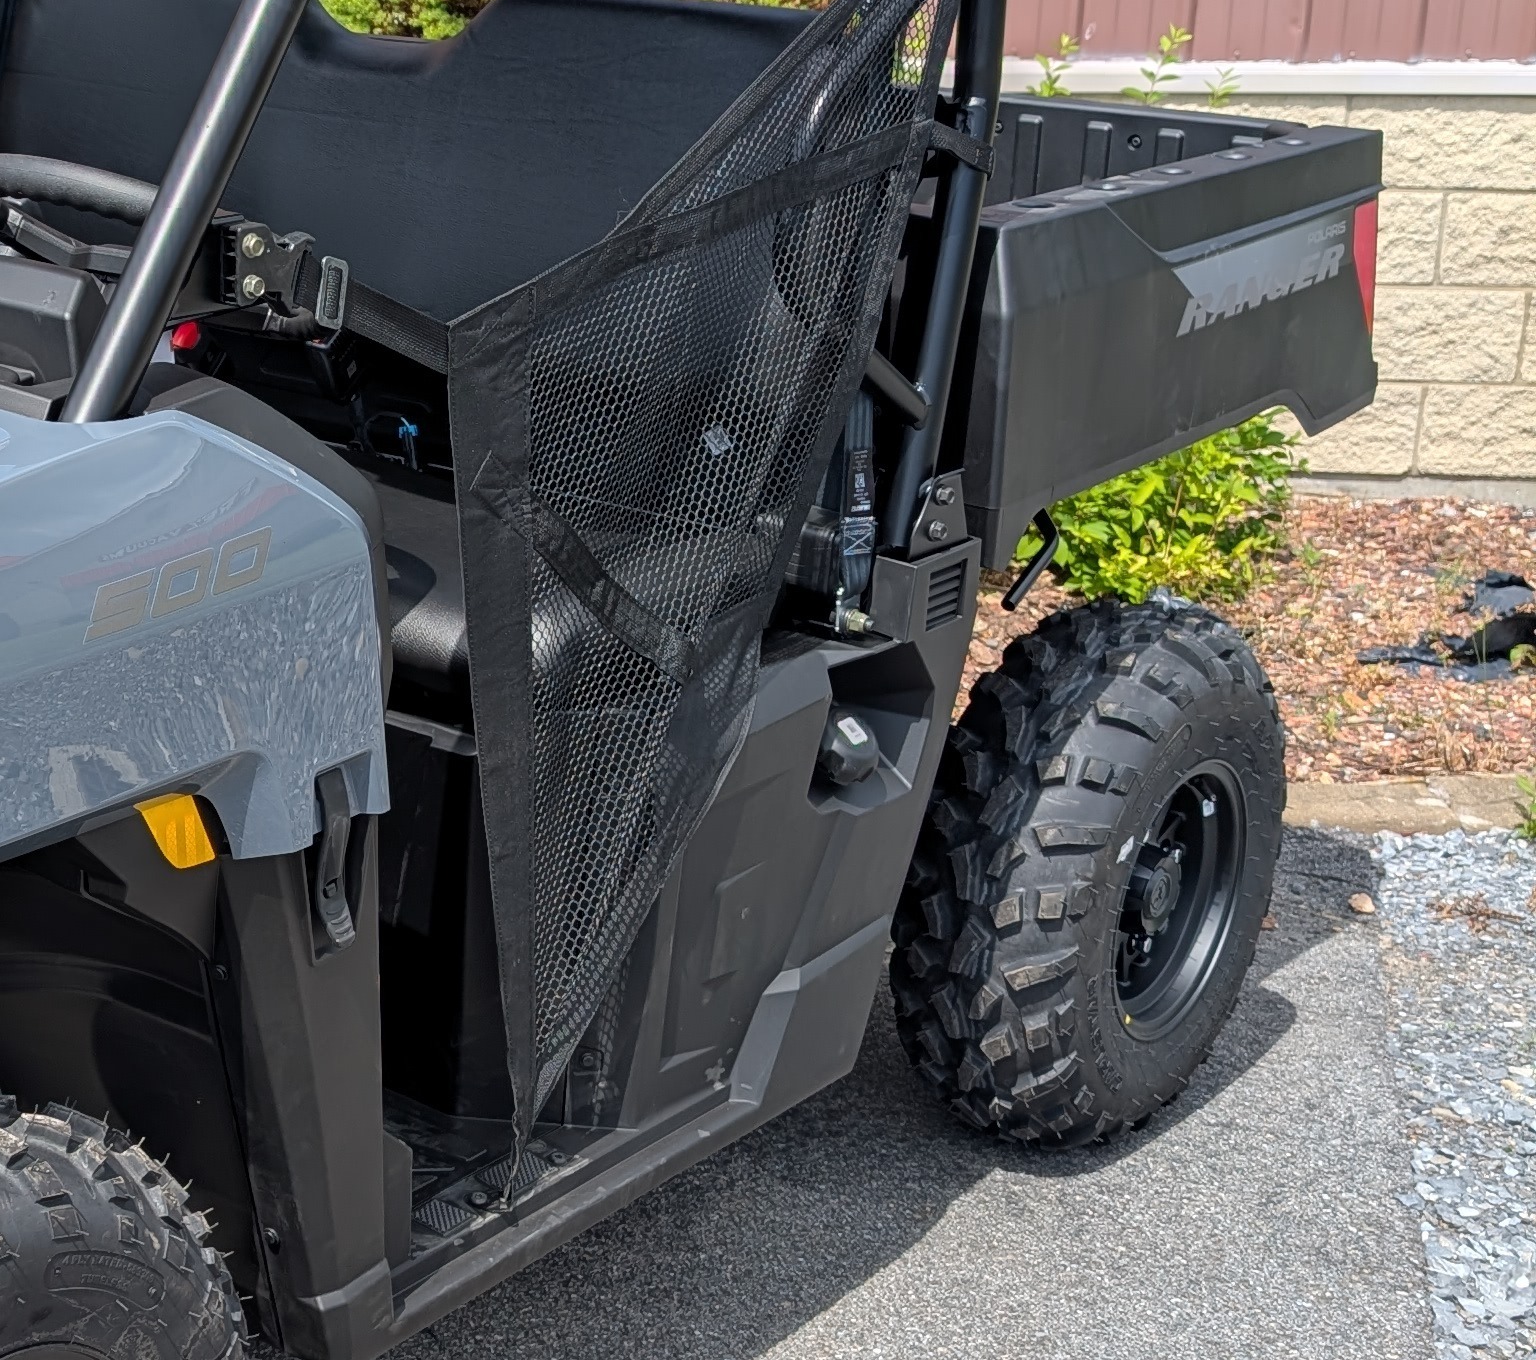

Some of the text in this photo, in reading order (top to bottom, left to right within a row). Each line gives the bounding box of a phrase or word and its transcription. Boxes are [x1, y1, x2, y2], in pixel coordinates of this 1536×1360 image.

[1307, 220, 1346, 244] POLARIS
[1175, 243, 1345, 338] RANGER
[82, 526, 272, 645] 500
